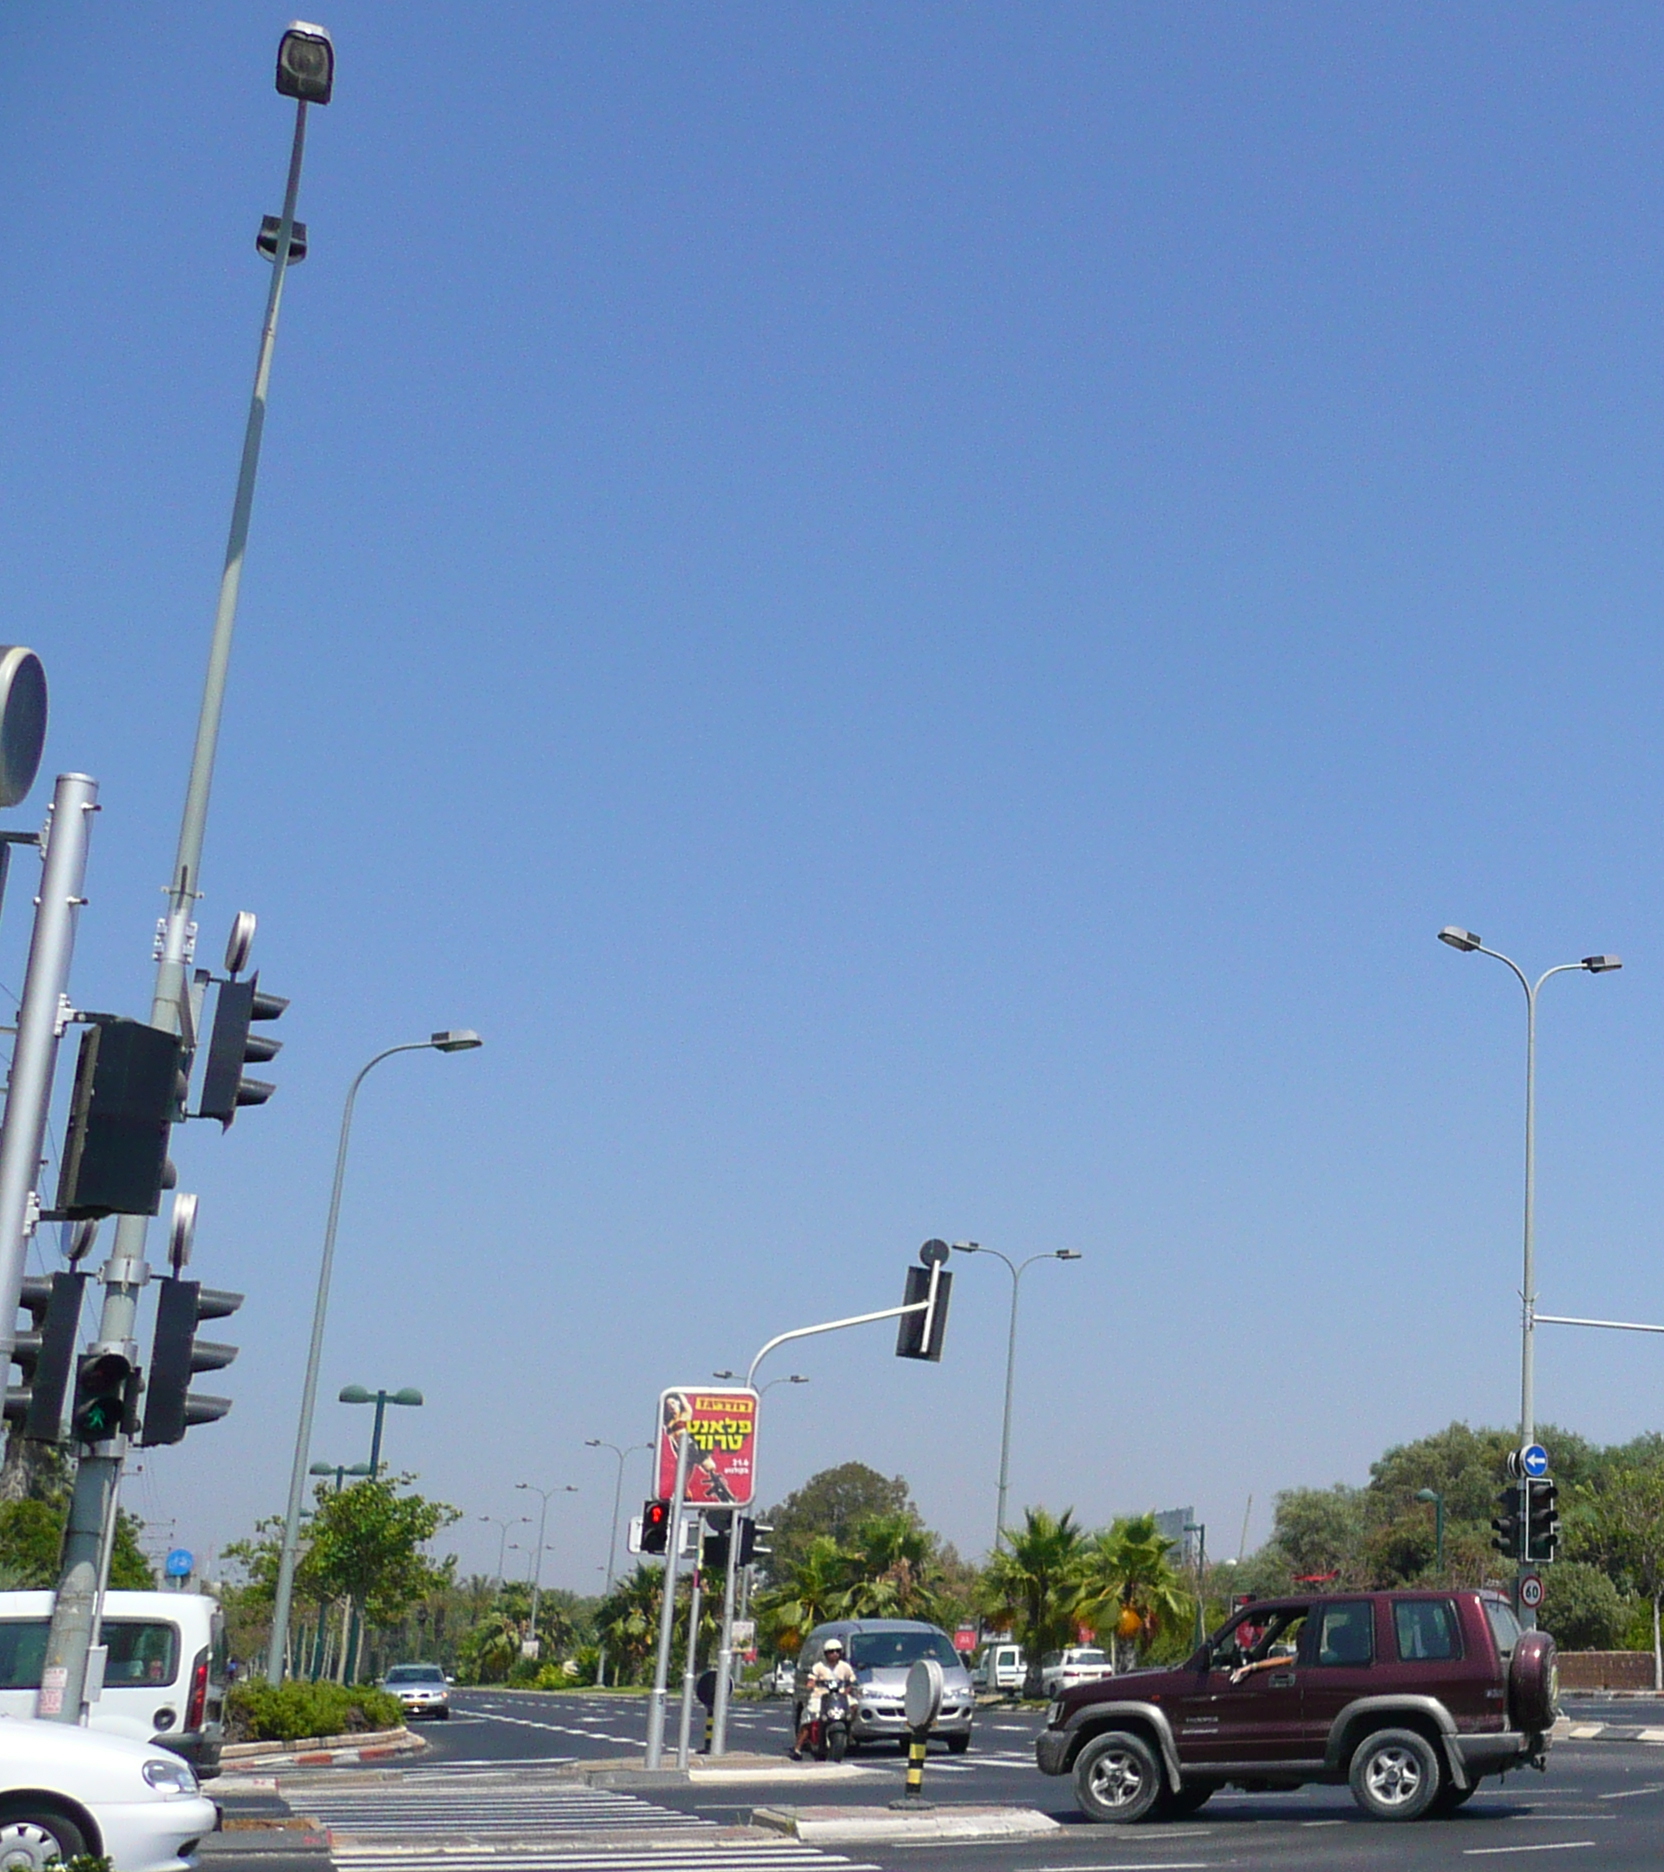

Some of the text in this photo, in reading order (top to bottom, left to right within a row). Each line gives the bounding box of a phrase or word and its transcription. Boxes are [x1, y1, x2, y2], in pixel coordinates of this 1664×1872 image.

[686, 1417, 753, 1434] פלאנט
[694, 1434, 744, 1451] טרור
[1525, 1585, 1539, 1599] 60
